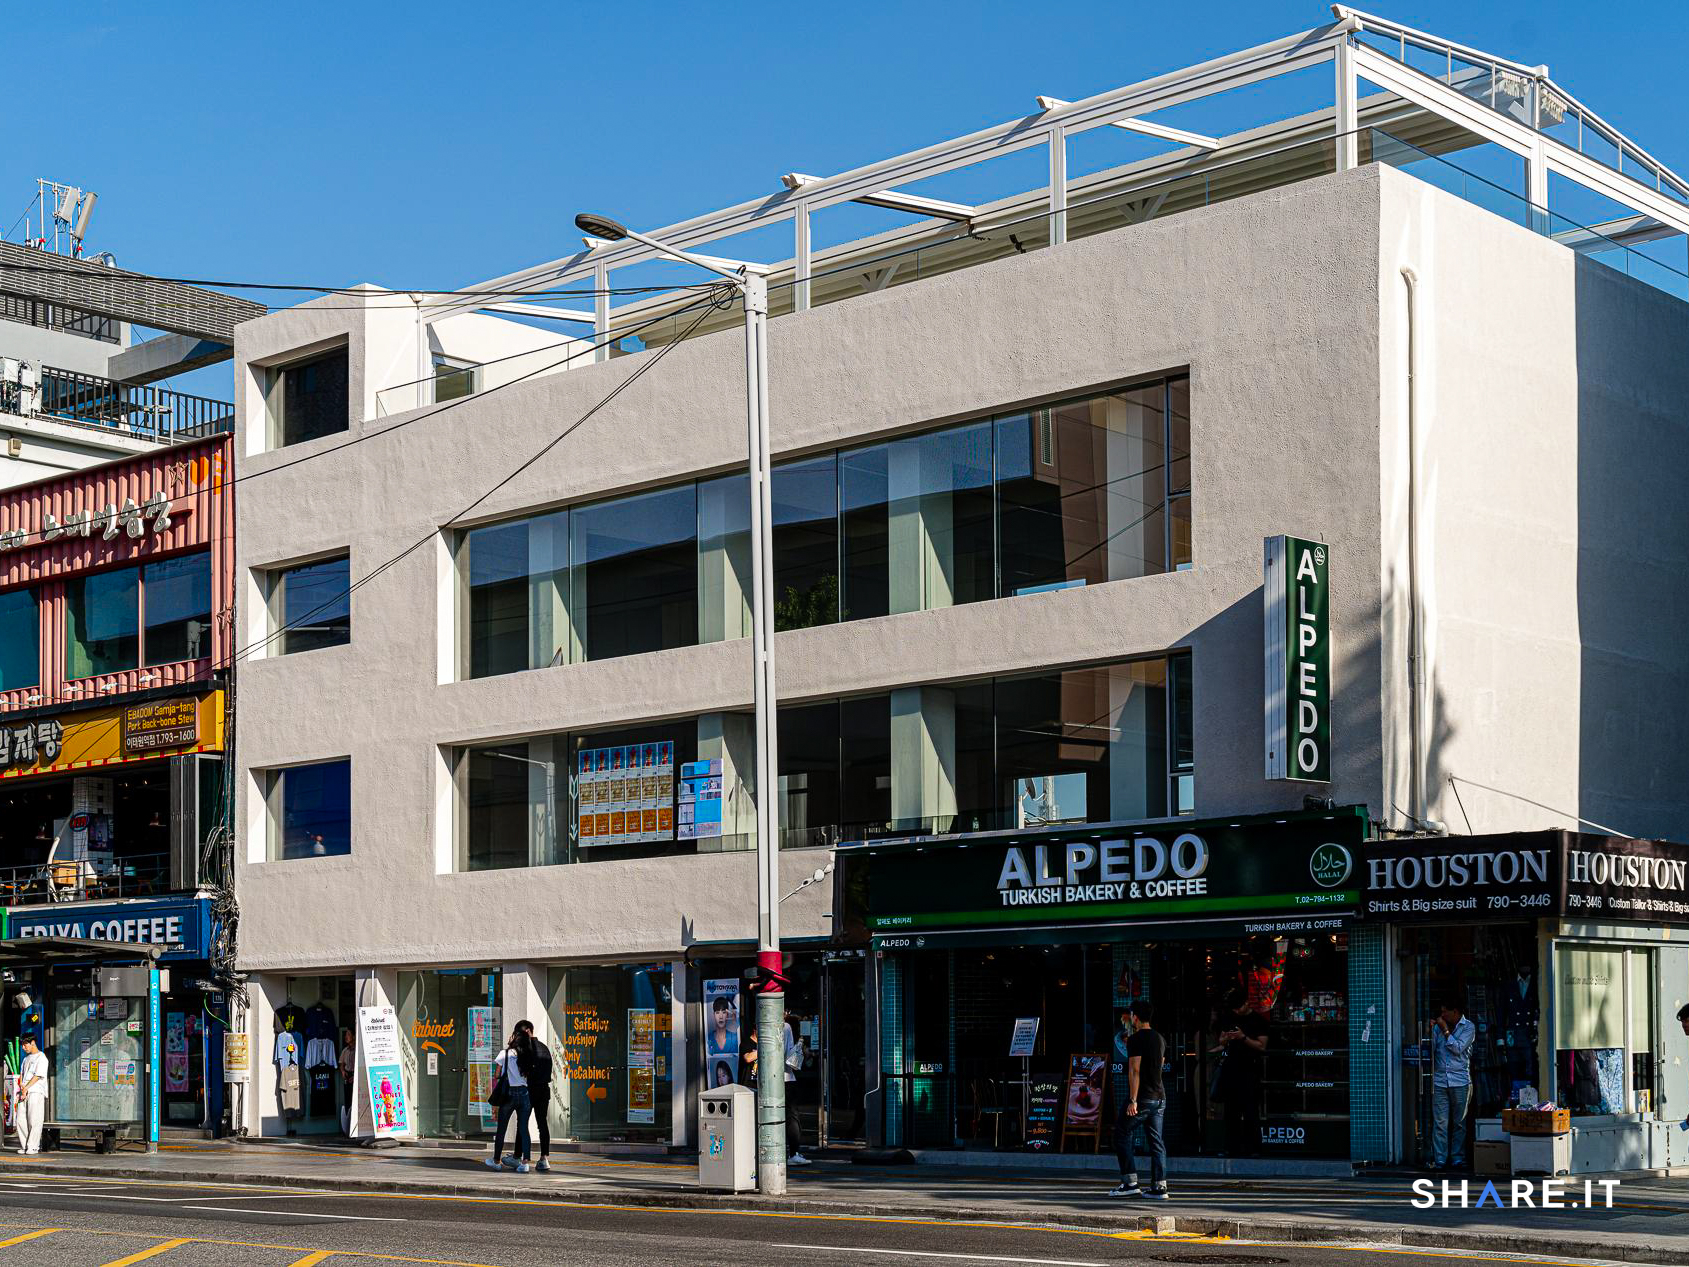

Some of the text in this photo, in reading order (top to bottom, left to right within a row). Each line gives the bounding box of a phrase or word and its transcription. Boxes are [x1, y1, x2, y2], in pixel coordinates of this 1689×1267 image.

[44, 491, 173, 541] 노래연습장
[1296, 548, 1318, 773] ALPEDO
[154, 702, 195, 716] Gamja-tang
[127, 714, 195, 731] Pork Back-bone Stew
[156, 729, 195, 745] T.793-1600
[997, 833, 1208, 890] ALPEDO
[1313, 852, 1346, 871] حلال
[1367, 850, 1550, 890] HOUSTON
[1572, 850, 1687, 891] HOUSTON
[1318, 871, 1342, 879] HALAL
[1000, 877, 1208, 906] TURKISH BAKERY & COFFEE
[1368, 894, 1551, 913] Shirts & Big size suit 790-3446
[1568, 894, 1602, 909] 790-3446
[1609, 896, 1630, 909] Custom
[1652, 899, 1669, 911] Shirts
[90, 916, 181, 945] COFFEE
[1244, 919, 1342, 932] TURKISH BAKERY & COFFEE
[880, 938, 910, 947] ALPEDO
[920, 1063, 943, 1071] ALPEDO
[1260, 1126, 1305, 1139] LPEDO
